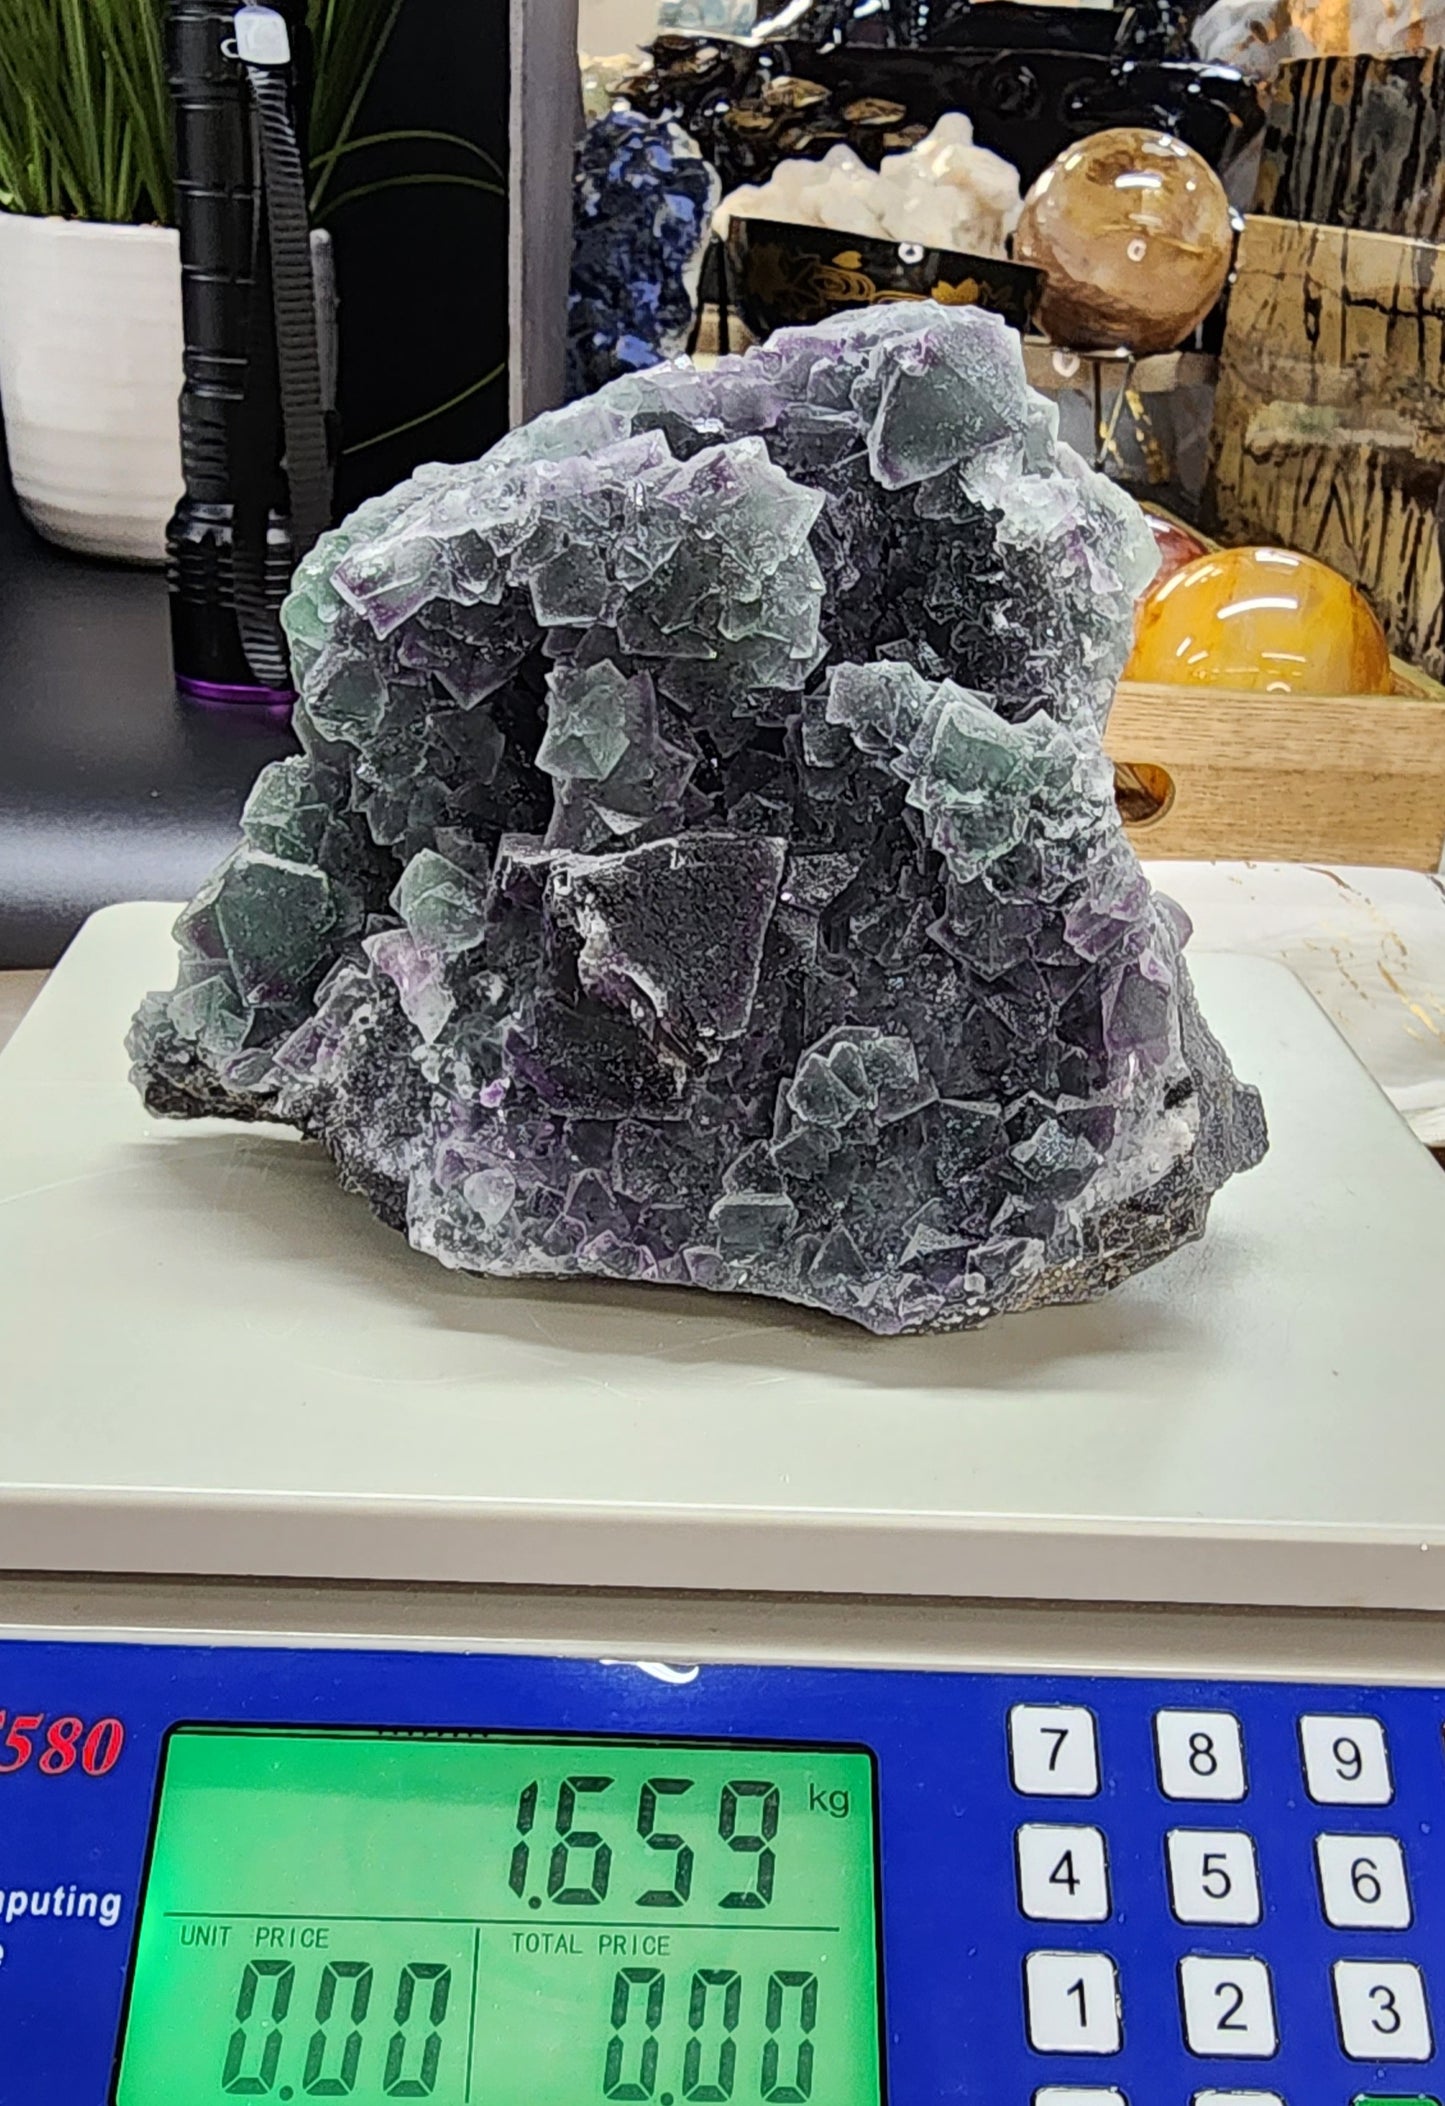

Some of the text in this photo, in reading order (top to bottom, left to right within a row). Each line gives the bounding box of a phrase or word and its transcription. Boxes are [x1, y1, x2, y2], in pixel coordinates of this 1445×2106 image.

[0, 1711, 125, 1776] 580
[1040, 1727, 1069, 1771] 7
[1189, 1732, 1218, 1776] 8
[1332, 1737, 1362, 1781] 9
[508, 1776, 855, 1909] 1.659 kg
[1049, 1849, 1081, 1895] 4
[1202, 1853, 1232, 1899] 5
[1350, 1857, 1381, 1904] 6
[0, 1885, 122, 1927] puting
[180, 1925, 330, 1949] UNIT PRICE
[512, 1932, 671, 1956] TOTAL PRICE
[1066, 1978, 1088, 2027] 1
[1215, 1982, 1248, 2031] 2
[1369, 1985, 1401, 2034] 3
[222, 1959, 452, 2101] 0.00
[602, 1967, 818, 2106] 0.00
